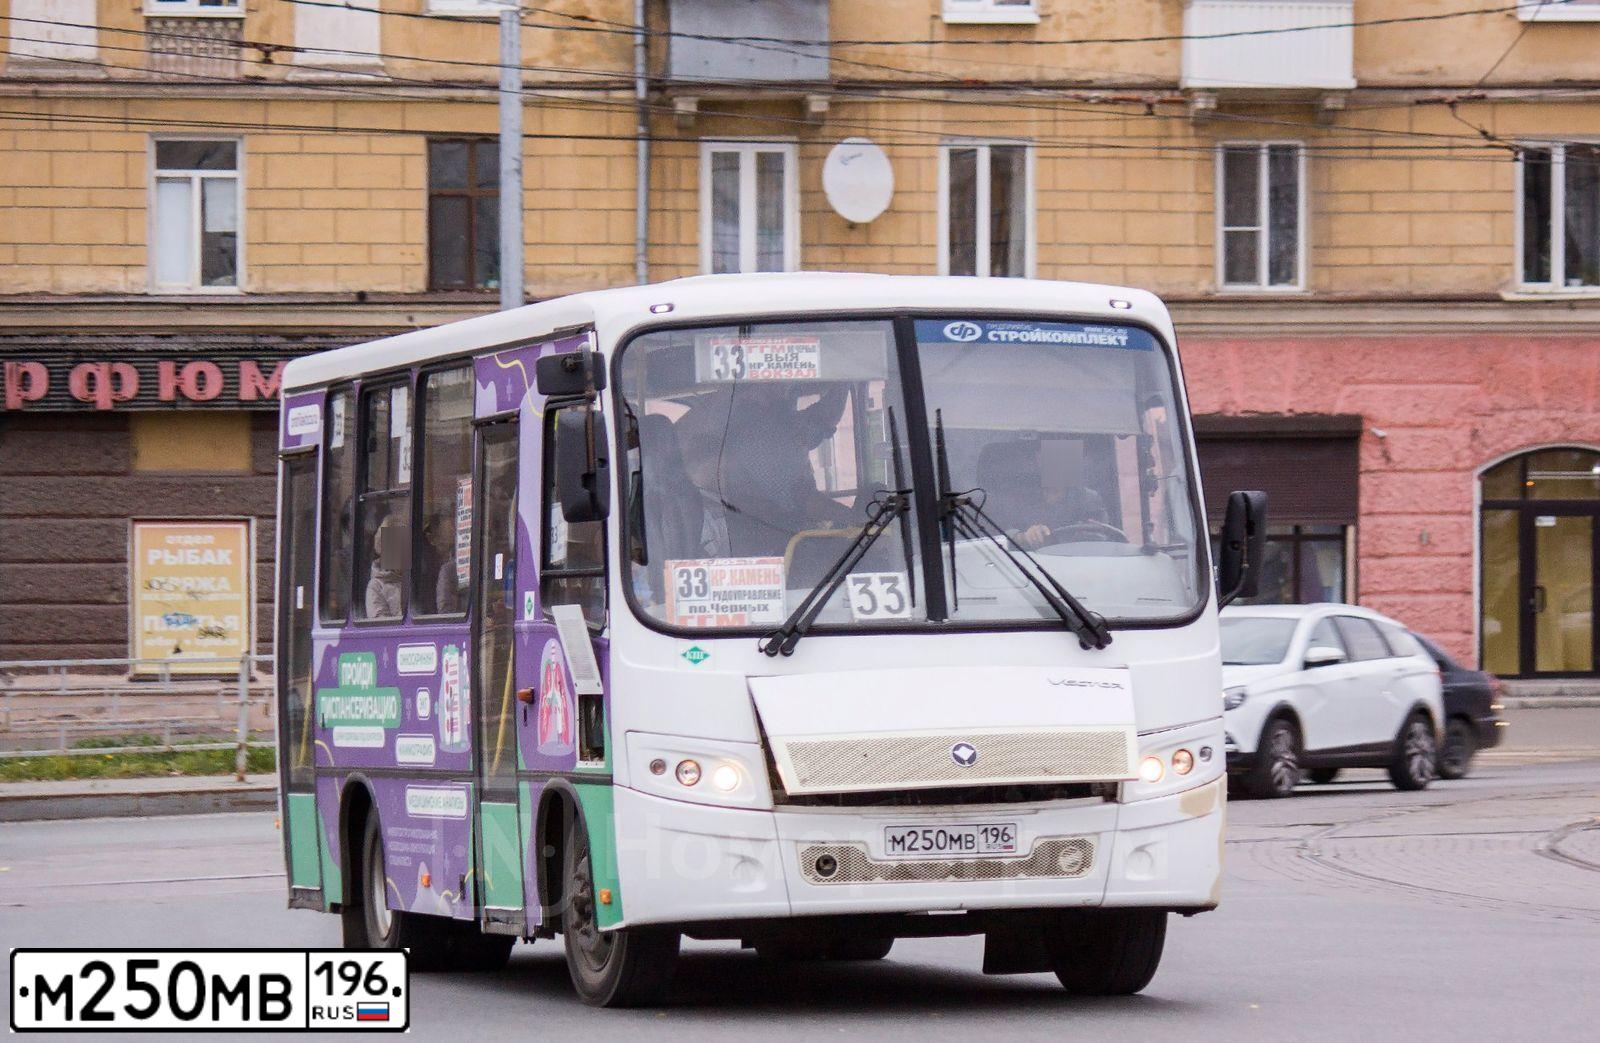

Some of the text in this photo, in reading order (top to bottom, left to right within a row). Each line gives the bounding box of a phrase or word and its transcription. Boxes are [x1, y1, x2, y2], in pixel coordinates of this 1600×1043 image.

[987, 328, 1129, 346] СТРОЙКОМПЛЕКТ
[714, 345, 746, 380] 33
[764, 353, 799, 362] ВЫЯ
[749, 368, 817, 378] ВОКЗАЛ
[147, 548, 232, 566] РЫБАК
[678, 568, 708, 598] 33
[713, 589, 782, 602] РУДОУПРАВЛЕНИЕ
[852, 576, 906, 616] 33
[341, 656, 373, 690] ПРОЙДИ
[891, 827, 1011, 852] М250МВ 196
